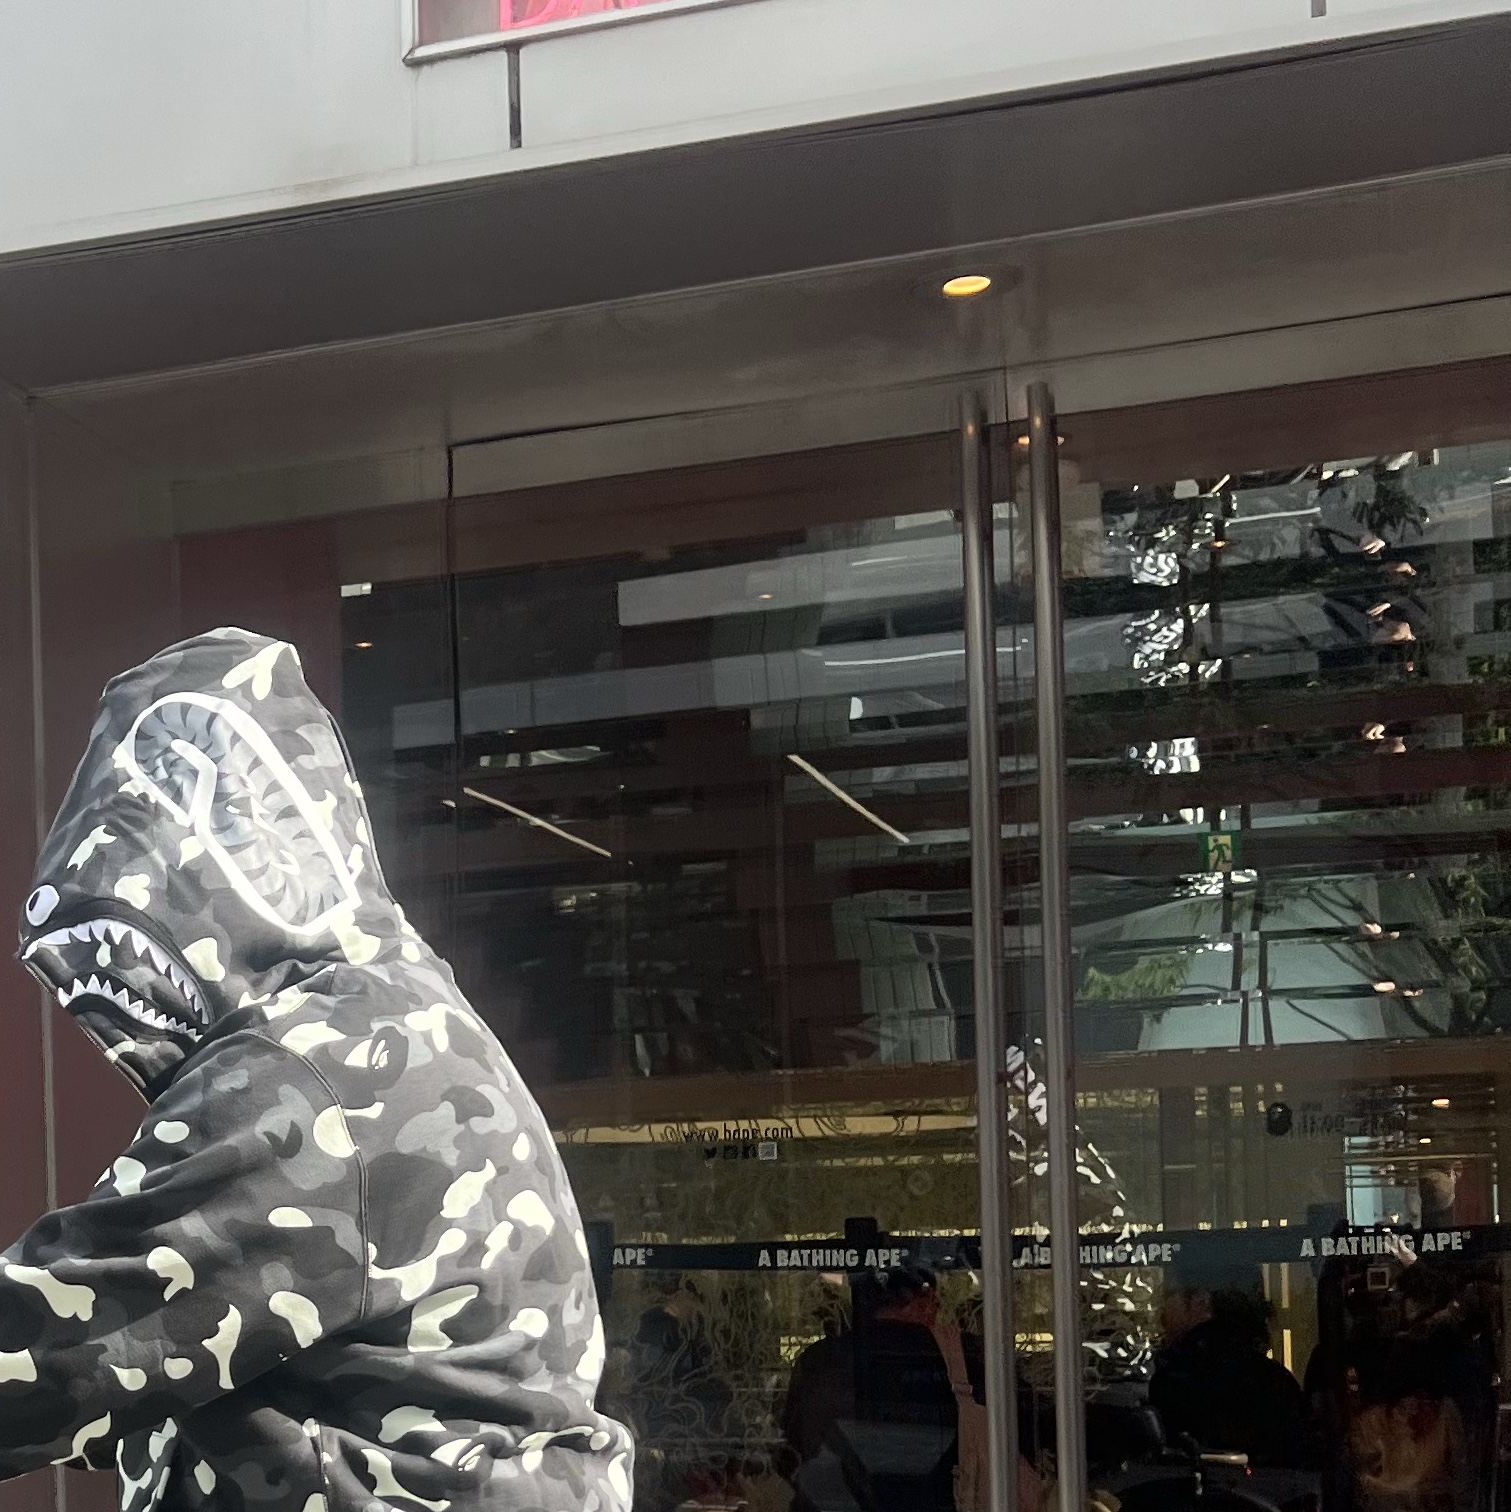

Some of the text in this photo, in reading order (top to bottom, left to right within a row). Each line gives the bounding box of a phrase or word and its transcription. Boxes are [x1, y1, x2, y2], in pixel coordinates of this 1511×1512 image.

[1039, 1244, 1127, 1265] BHING
[1299, 1237, 1316, 1257] A
[757, 1248, 772, 1267] A
[776, 1248, 859, 1267] BATHING
